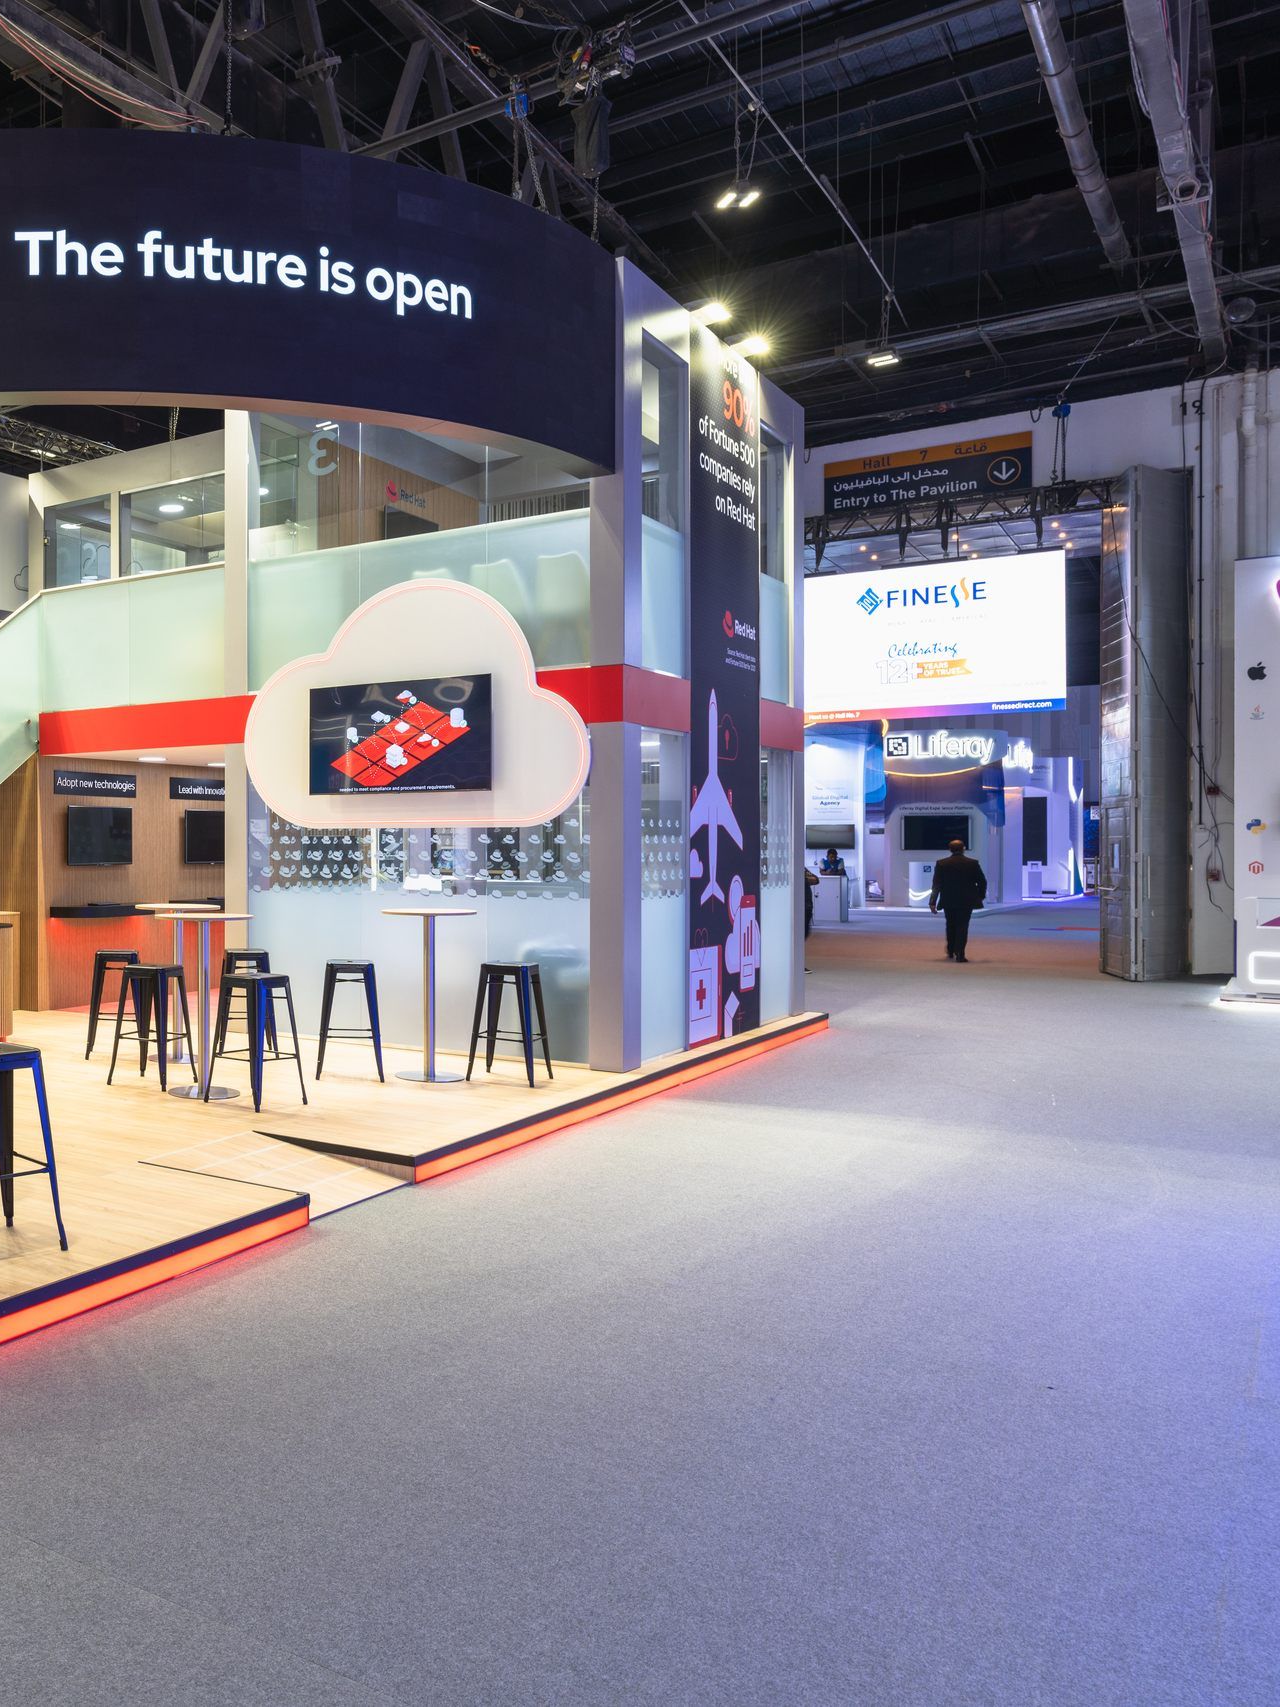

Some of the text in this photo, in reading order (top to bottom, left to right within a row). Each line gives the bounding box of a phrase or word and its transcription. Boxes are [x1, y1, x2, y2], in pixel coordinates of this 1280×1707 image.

[14, 229, 473, 319] The future is open
[723, 380, 755, 437] 90%
[698, 415, 755, 468] of Fortune 500
[954, 442, 988, 456] قاعة
[863, 450, 928, 470] Hall 7
[699, 452, 756, 504] companies rely
[833, 467, 949, 492] مدخل إلى البافيليون
[834, 480, 978, 509] Entry to The Pavilion
[715, 495, 756, 531] on Red Hat
[887, 577, 987, 608] FINESSE
[735, 619, 745, 637] Red
[888, 643, 958, 659] Celebrating
[923, 661, 949, 670] YEARS
[924, 668, 935, 677] OF
[991, 700, 1053, 711] finessedirect.com
[916, 731, 994, 763] Liferay
[56, 776, 136, 793] Adopt new technologies
[178, 785, 192, 794] Lead
[192, 786, 204, 795] with
